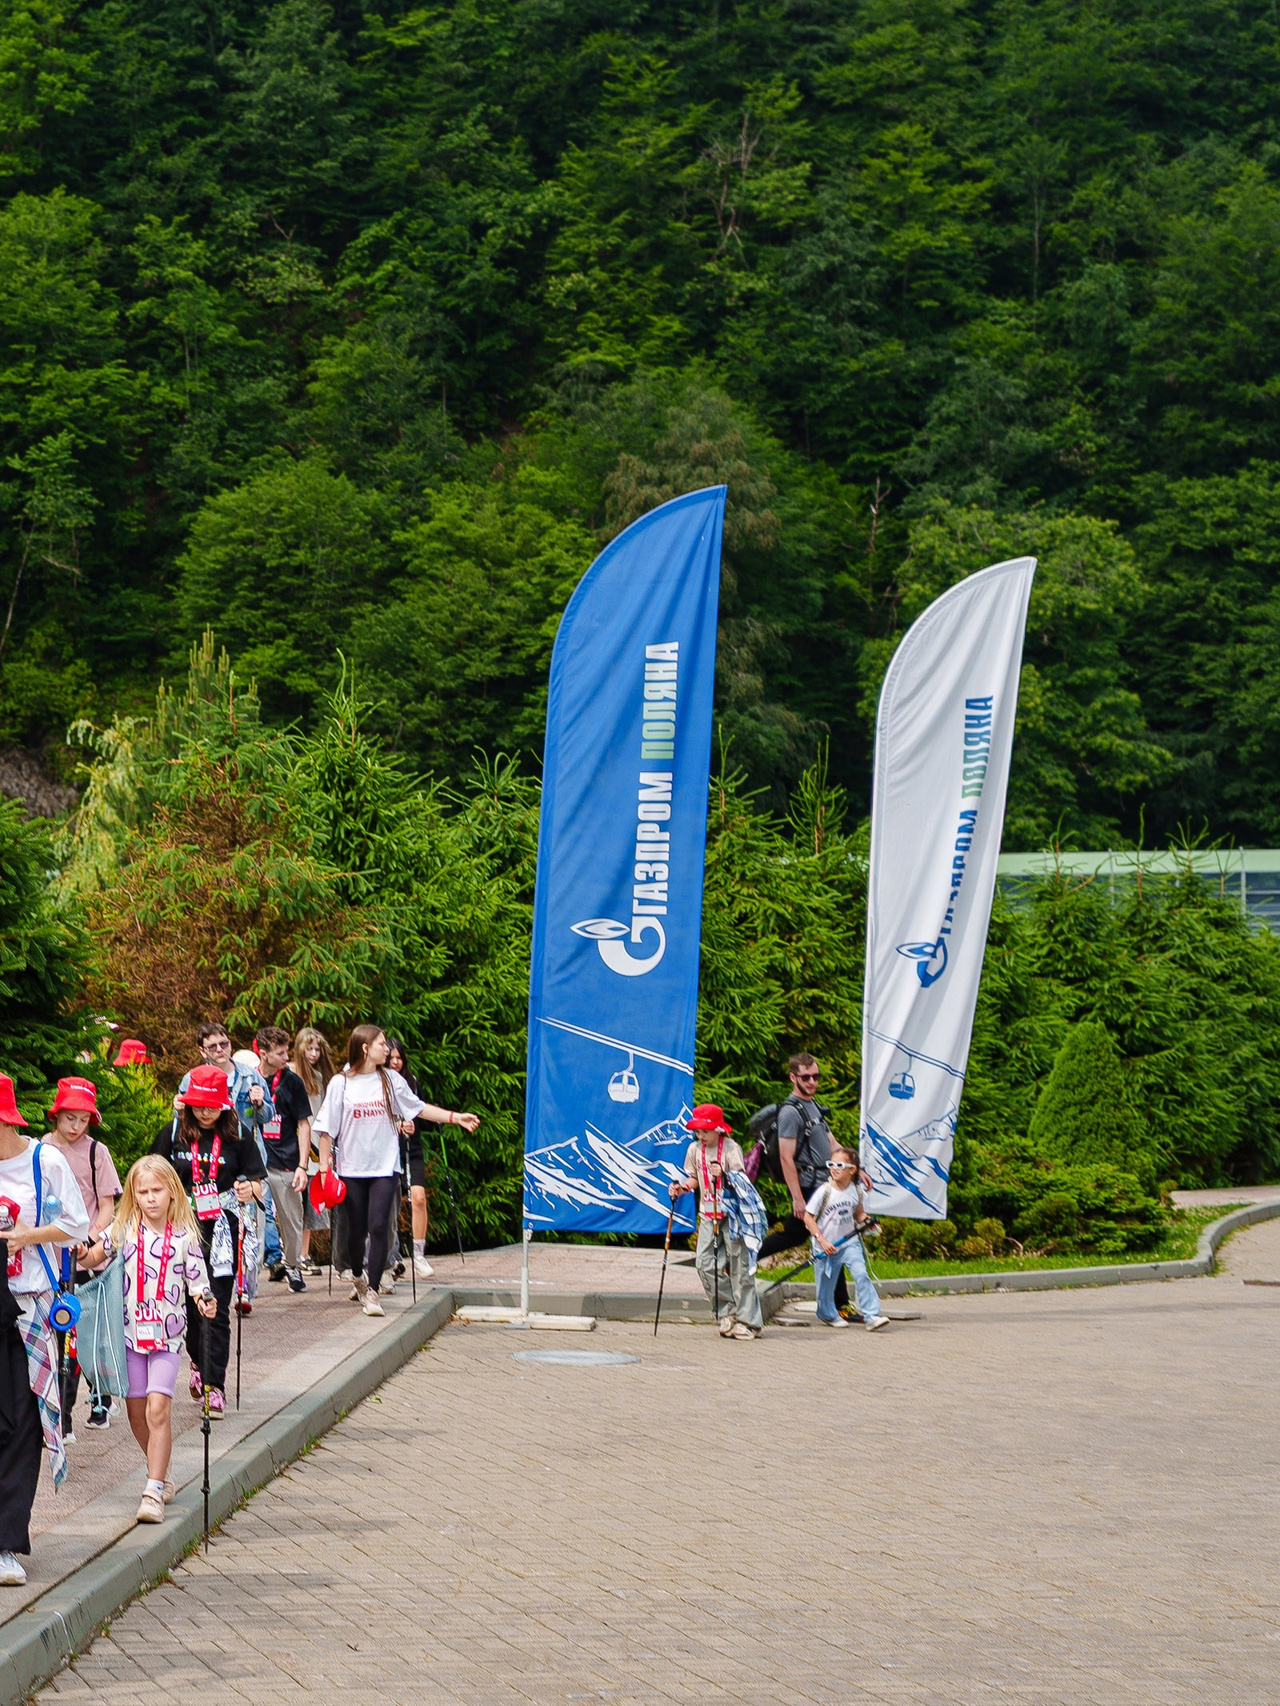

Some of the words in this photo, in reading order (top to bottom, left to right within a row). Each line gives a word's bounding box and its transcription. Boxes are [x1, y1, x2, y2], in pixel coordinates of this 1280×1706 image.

[641, 640, 680, 760] ПОЛЯНА
[961, 694, 994, 799] ПОЛЯНА
[632, 771, 673, 916] ГАЗПРОМ
[192, 1182, 218, 1197] JUN
[134, 1308, 163, 1321] JUN
